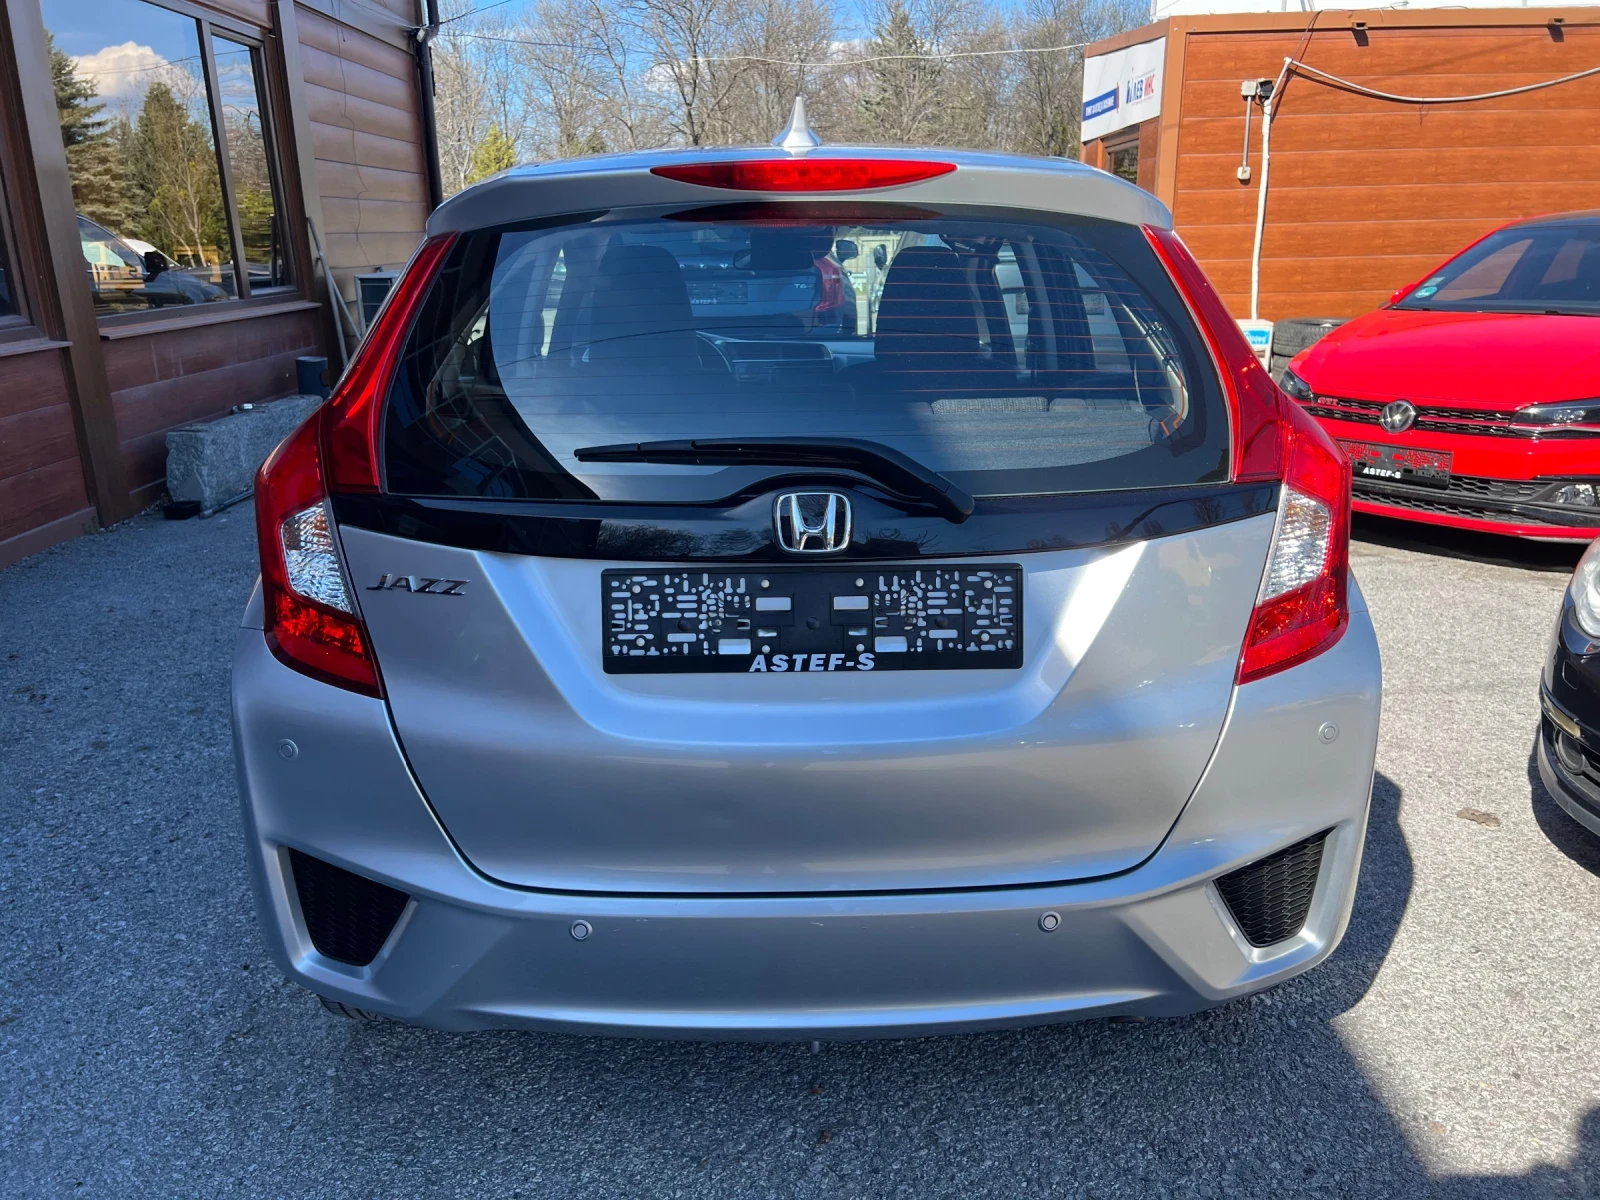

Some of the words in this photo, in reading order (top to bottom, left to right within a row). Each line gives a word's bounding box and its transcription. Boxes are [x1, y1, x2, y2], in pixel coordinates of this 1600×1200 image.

[1317, 396, 1338, 406] GTI
[1362, 466, 1402, 479] ASTEF-S
[366, 573, 471, 596] JAZZ
[749, 652, 876, 672] ASTEF-S
